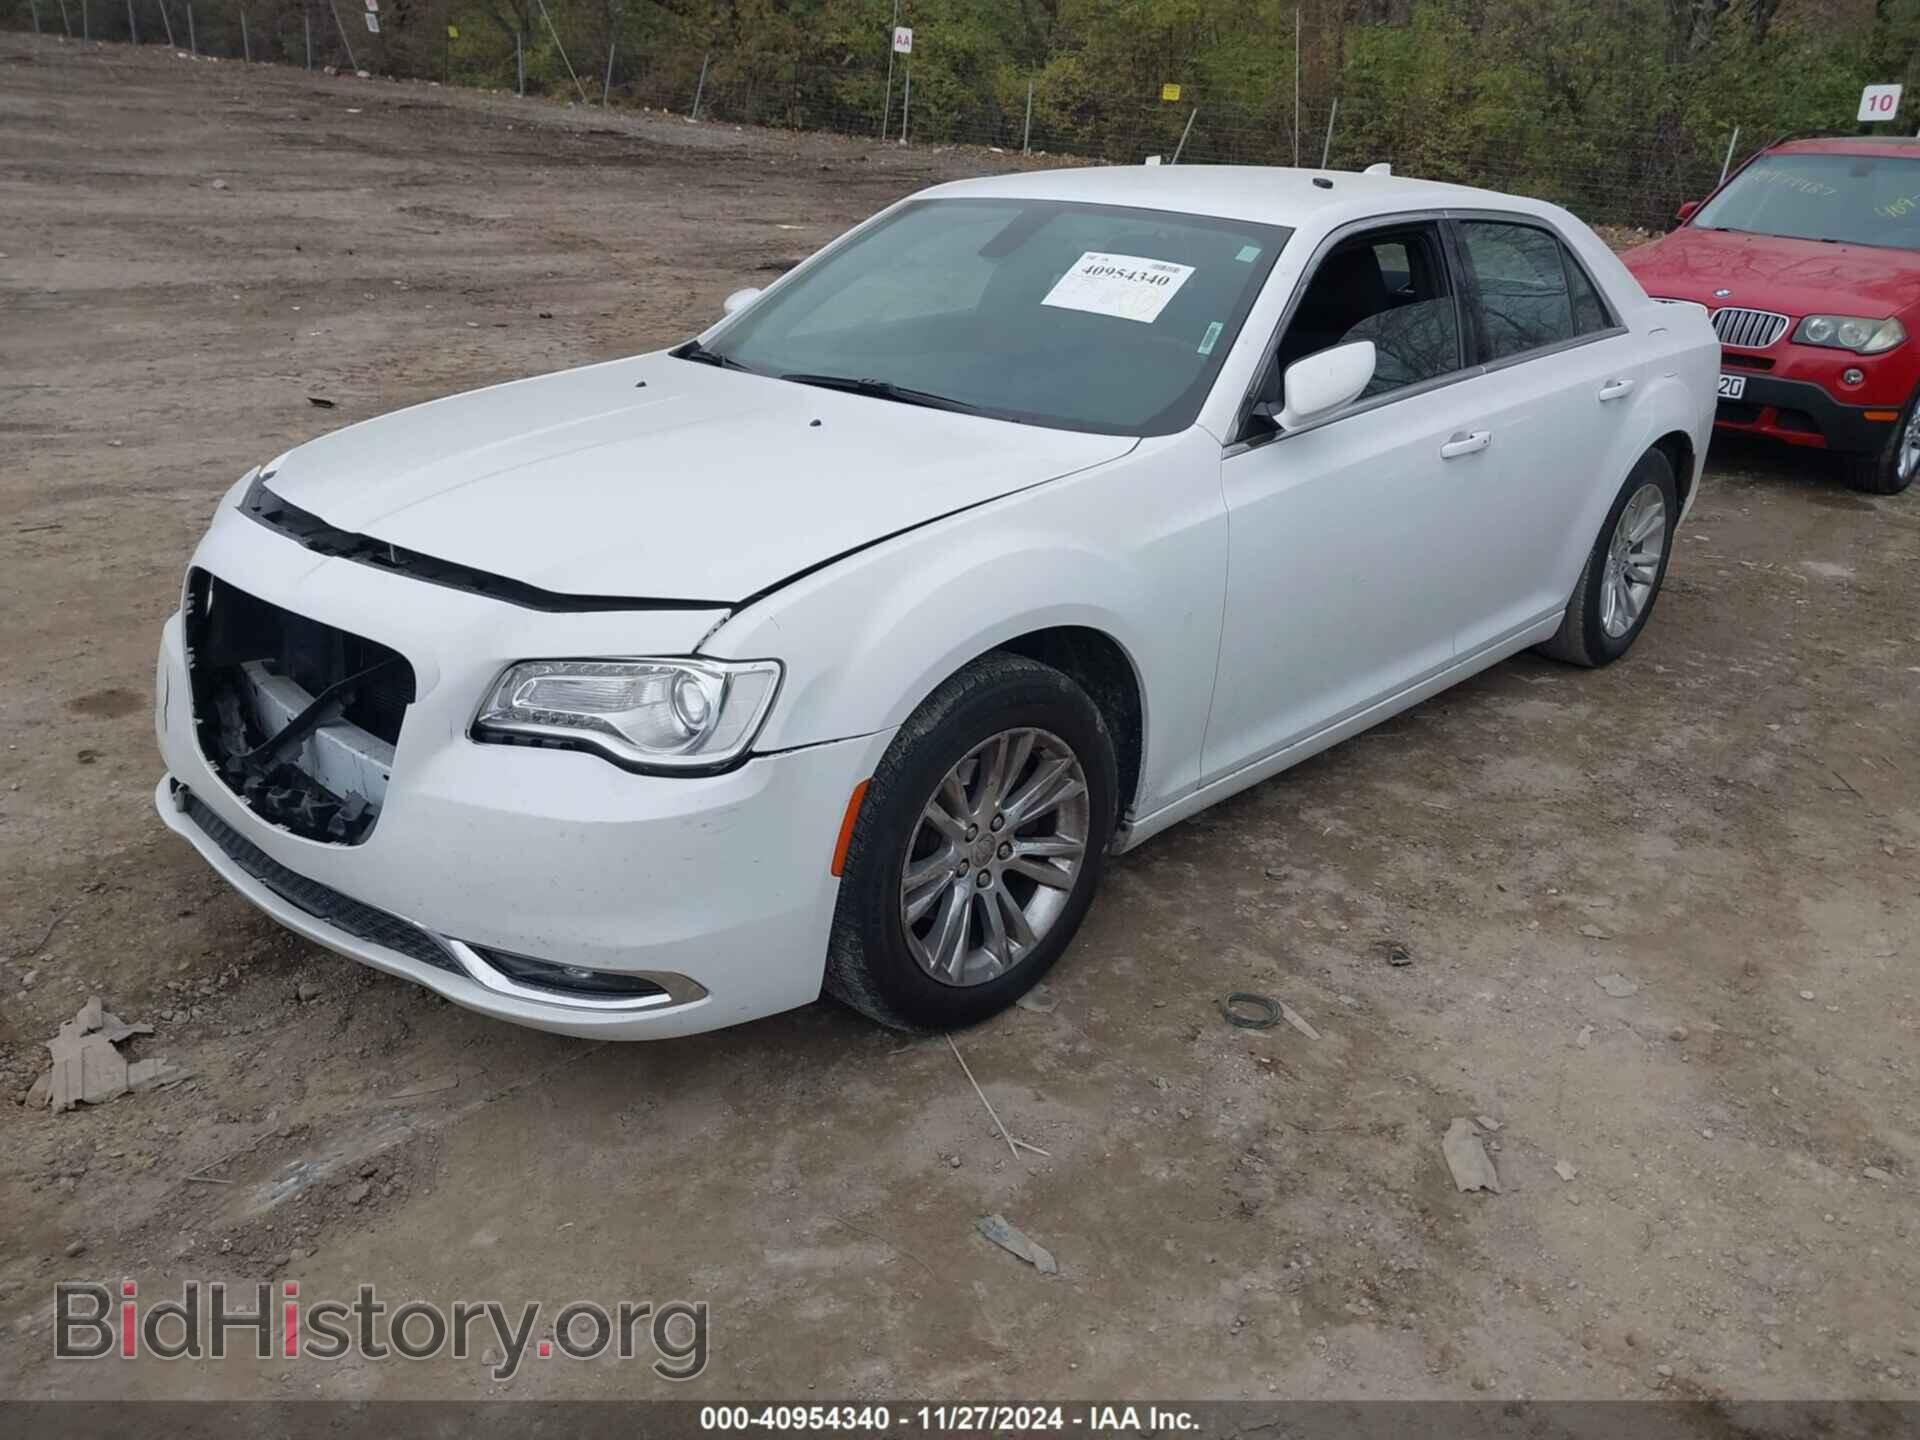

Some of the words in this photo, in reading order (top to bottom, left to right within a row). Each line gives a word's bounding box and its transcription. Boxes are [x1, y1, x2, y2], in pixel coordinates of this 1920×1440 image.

[896, 34, 910, 45] AA
[1868, 94, 1893, 111] 10
[1082, 264, 1170, 286] 40954340
